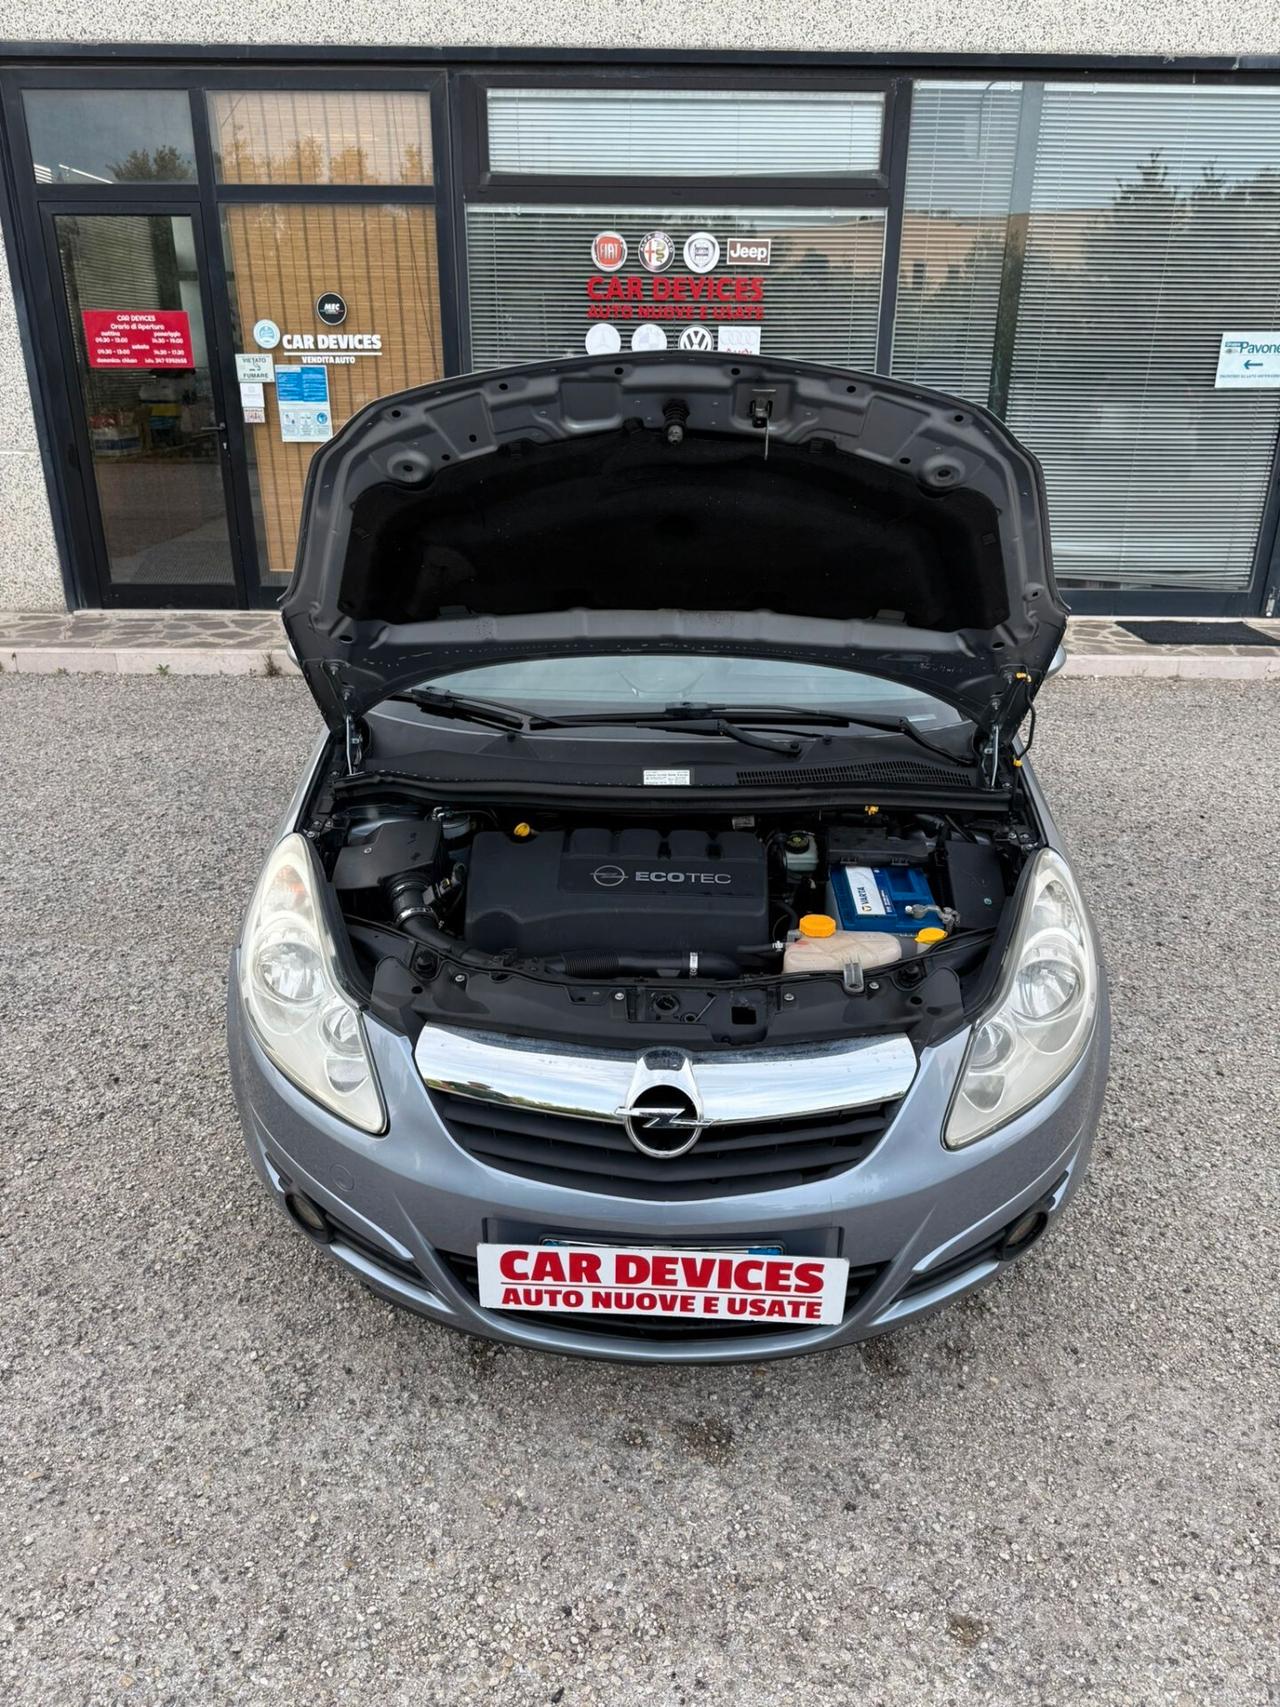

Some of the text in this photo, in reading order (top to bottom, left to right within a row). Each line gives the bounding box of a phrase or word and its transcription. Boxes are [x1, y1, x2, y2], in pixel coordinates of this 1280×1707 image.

[600, 243, 618, 259] FIAT
[730, 243, 767, 261] Jeep
[587, 276, 764, 302] CAR DEVICES
[588, 305, 764, 320] AUTO NUOVE E USATE
[282, 334, 316, 350] CAR
[317, 334, 382, 350] DEVICES
[301, 356, 356, 364] VENDITA AUTO
[635, 871, 732, 884] ECOTEC
[857, 886, 868, 905] VARTA
[499, 1249, 825, 1294] CAR DEVICES
[502, 1287, 822, 1319] AUTO NUOVE E USATE
